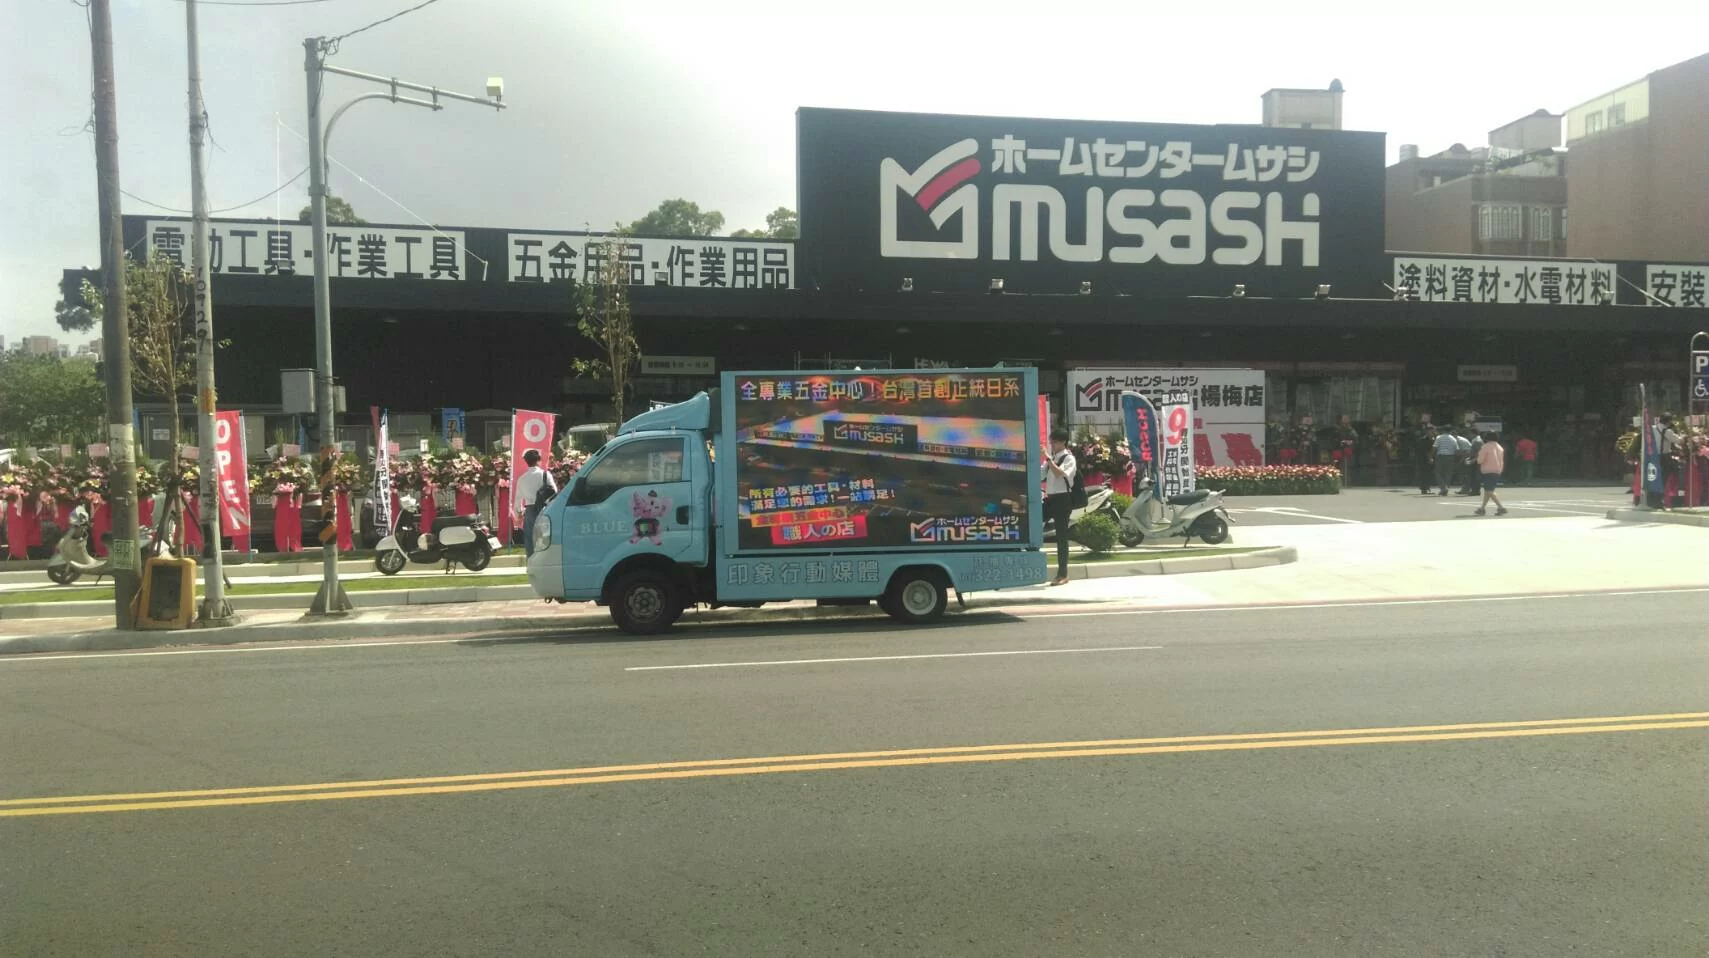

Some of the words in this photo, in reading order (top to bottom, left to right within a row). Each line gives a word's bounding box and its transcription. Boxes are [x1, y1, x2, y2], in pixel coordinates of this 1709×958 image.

[991, 134, 1320, 183] ホームセンタームサシ
[1695, 355, 1708, 373] P
[1105, 375, 1199, 387] ホームセンタームサシ
[1201, 384, 1264, 408] 楊梅店
[580, 520, 629, 534] BLUE
[936, 515, 1020, 526] ホームセンタームサシ
[782, 520, 856, 541] 職人の店
[728, 560, 880, 585] 印象行動媒體
